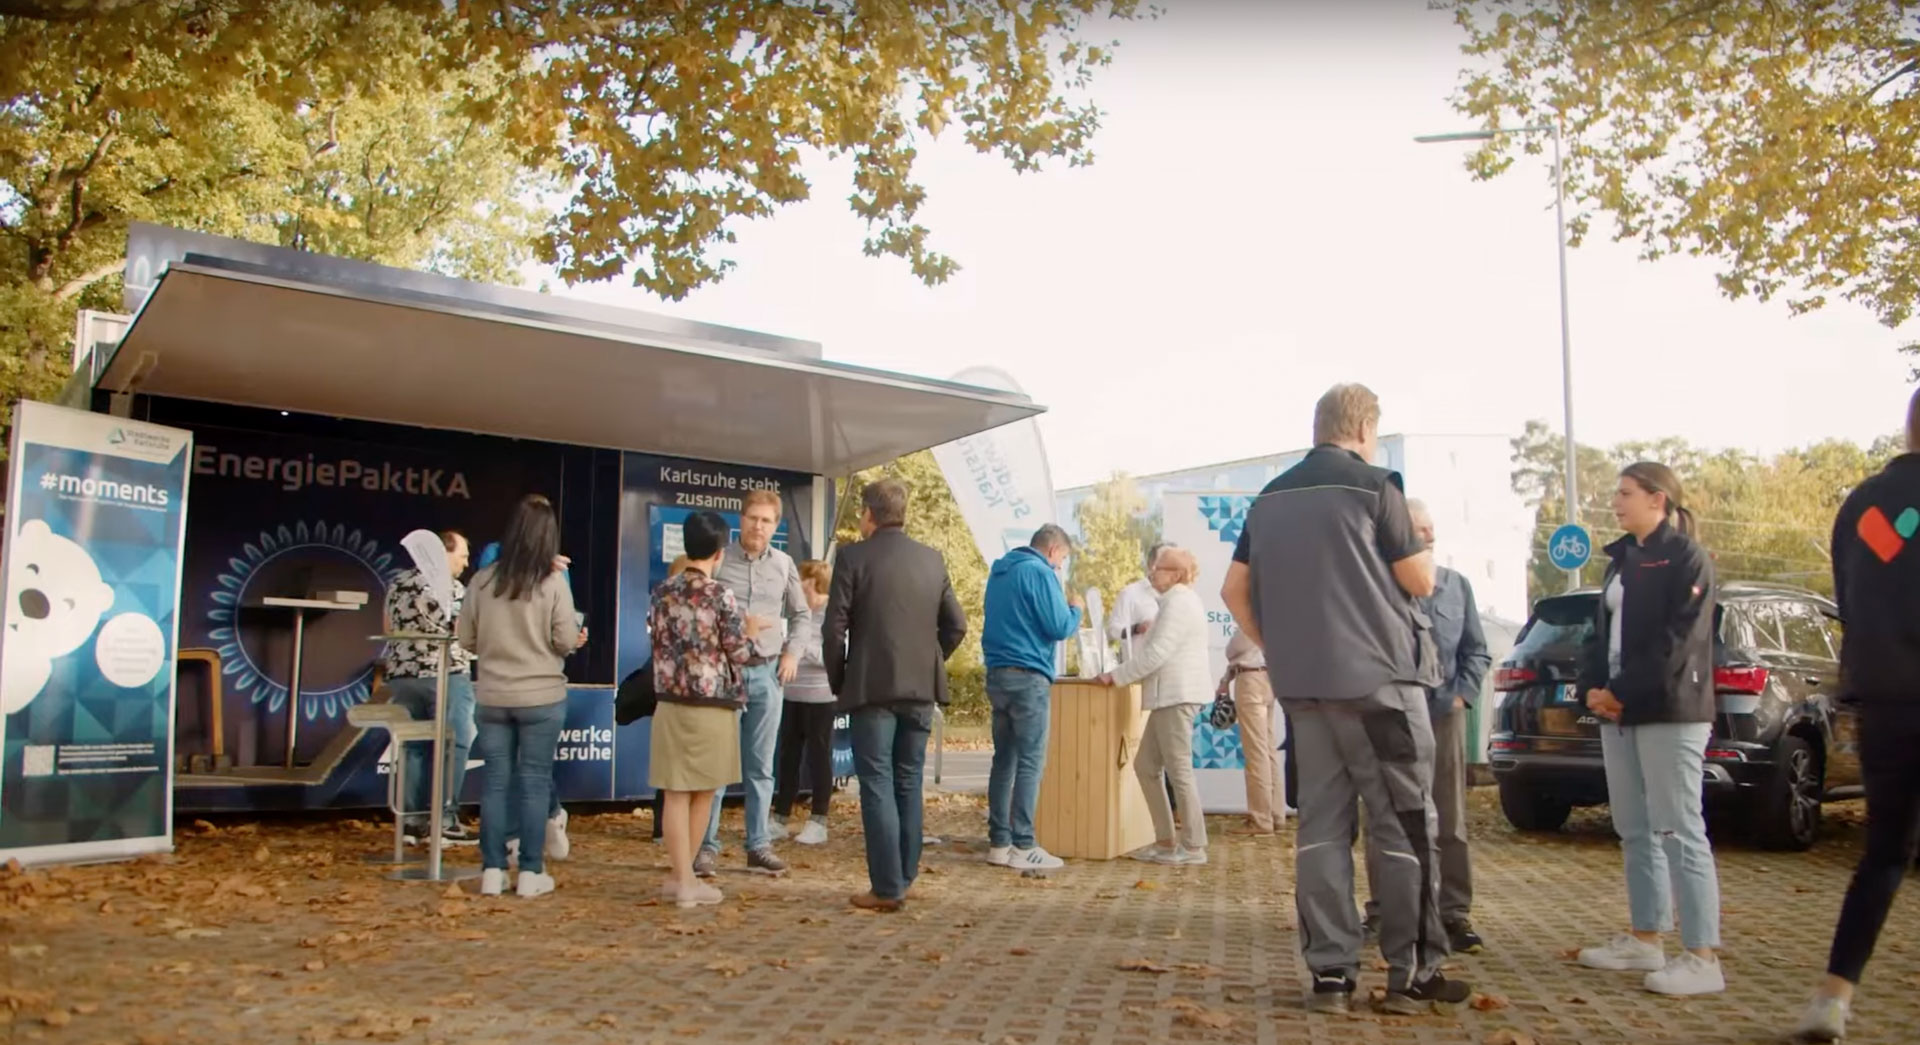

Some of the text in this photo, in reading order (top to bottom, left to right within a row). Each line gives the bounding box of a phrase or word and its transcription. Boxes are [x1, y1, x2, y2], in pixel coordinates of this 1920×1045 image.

[40, 472, 168, 505] #moments
[660, 466, 781, 494] Karlsruhe steht
[676, 492, 742, 511] zusamm
[1207, 611, 1234, 623] Sta
[557, 725, 612, 743] werke
[552, 743, 612, 761] lsruhe
